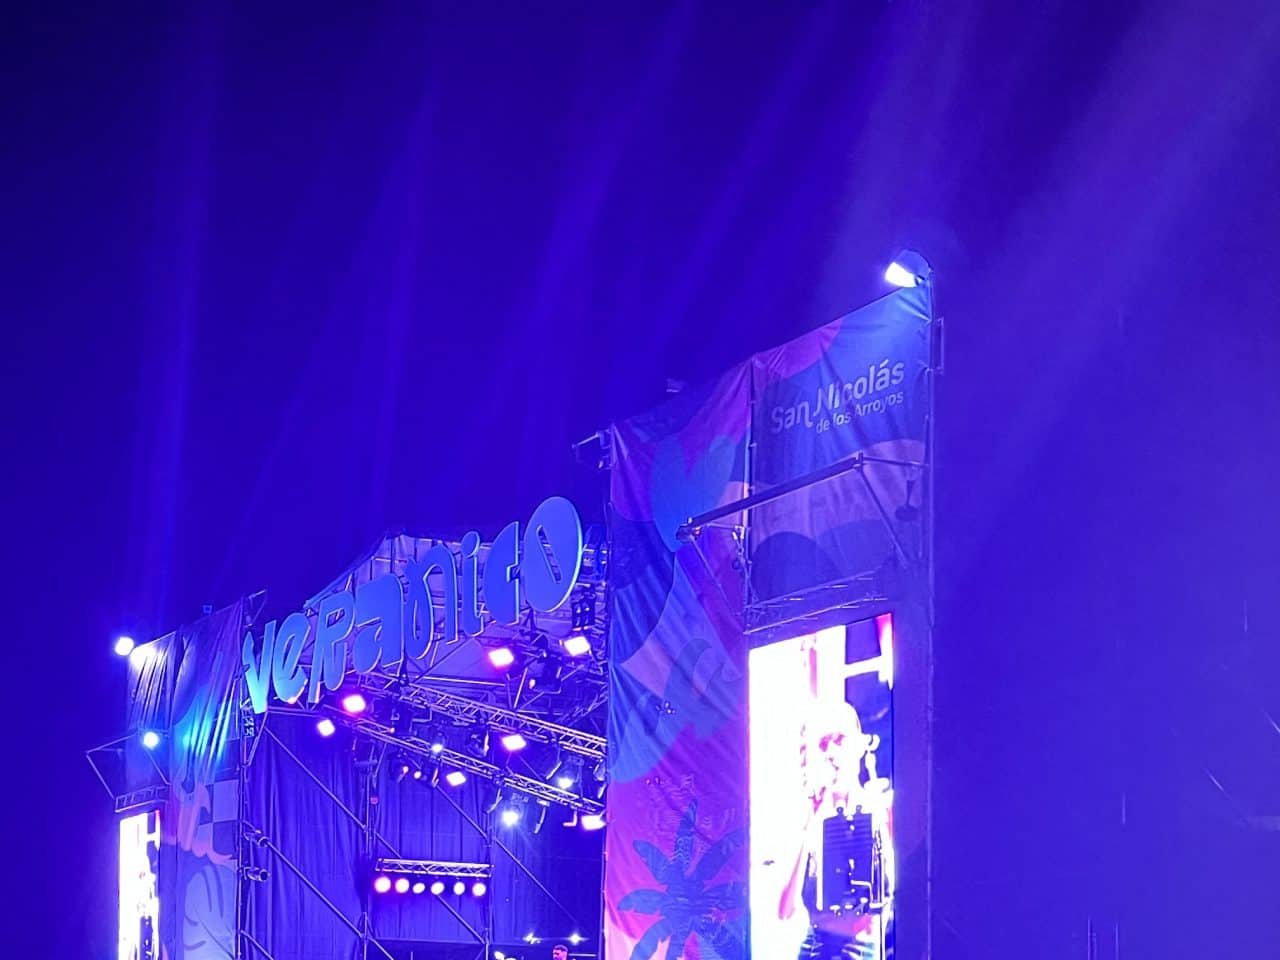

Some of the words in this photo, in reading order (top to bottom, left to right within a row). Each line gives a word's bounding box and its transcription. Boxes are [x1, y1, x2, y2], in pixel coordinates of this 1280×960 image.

[771, 401, 813, 433] San
[813, 359, 904, 417] Nicolás
[816, 416, 830, 434] de
[833, 412, 851, 427] los
[855, 391, 904, 417] Arroyos
